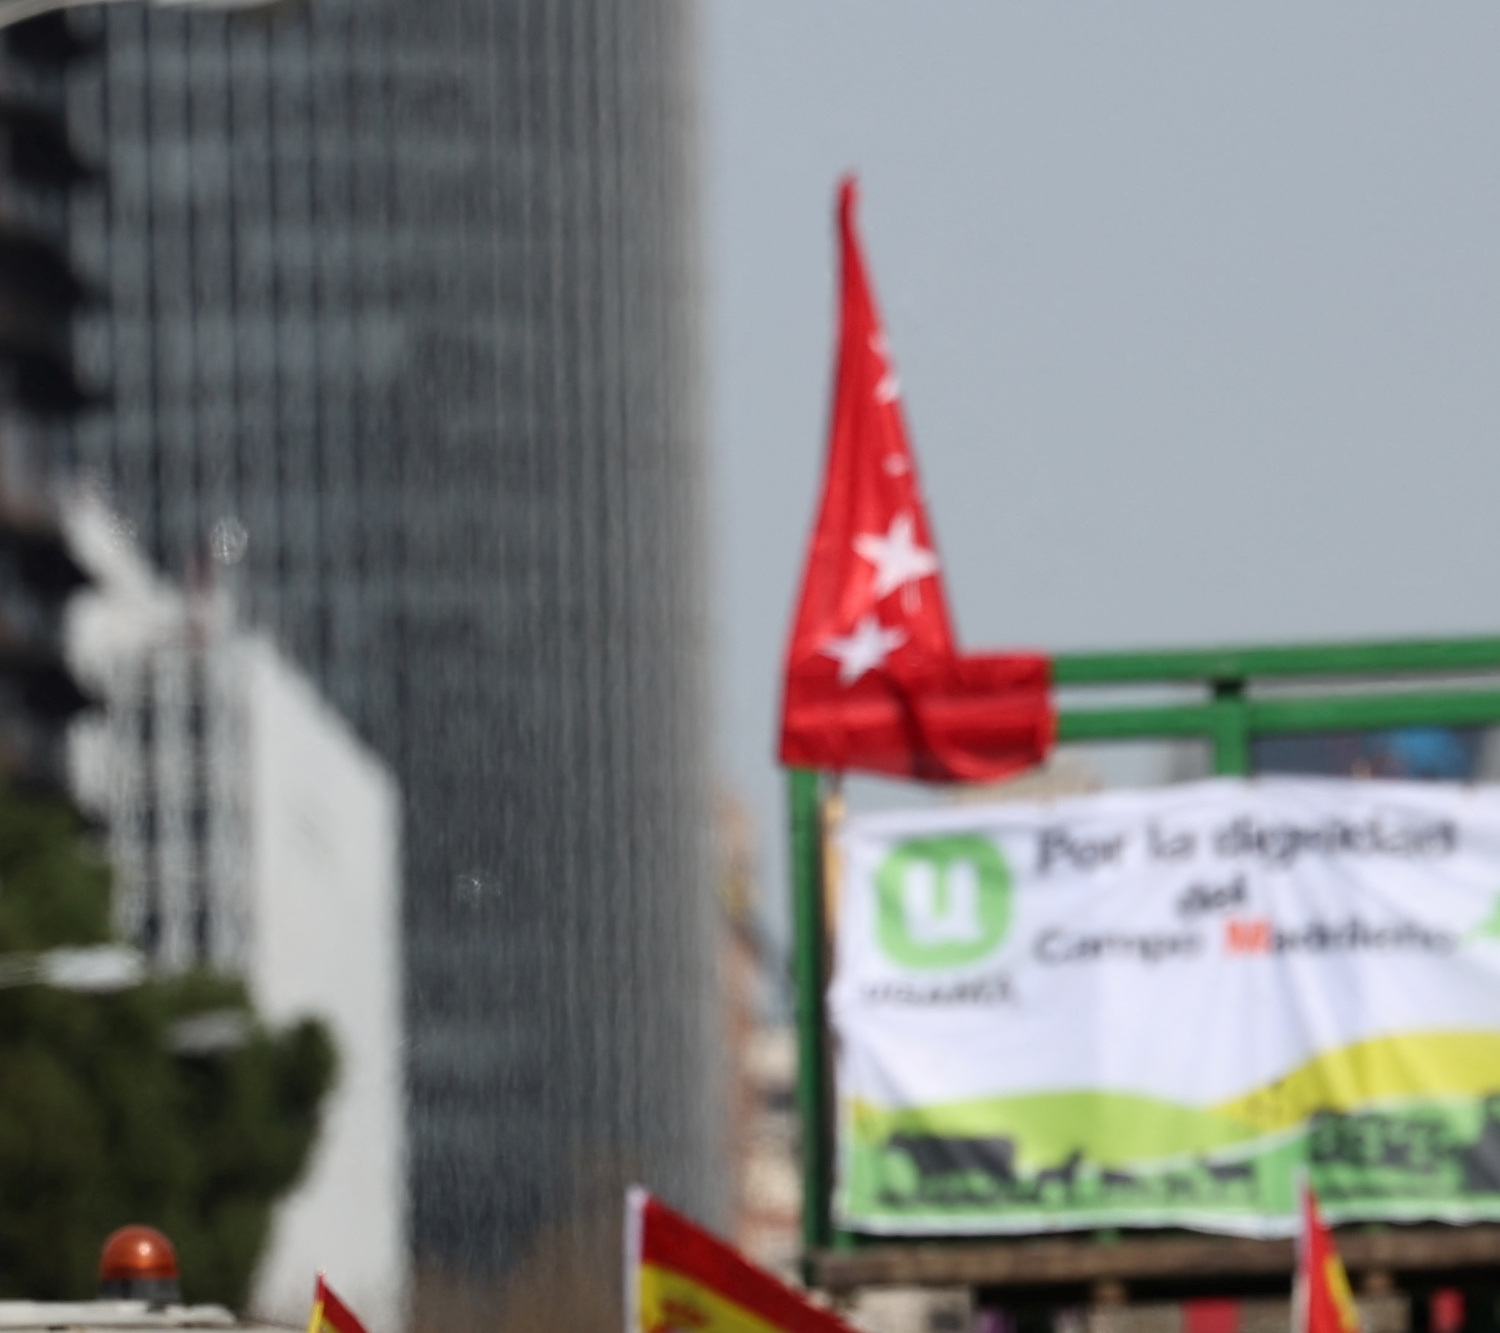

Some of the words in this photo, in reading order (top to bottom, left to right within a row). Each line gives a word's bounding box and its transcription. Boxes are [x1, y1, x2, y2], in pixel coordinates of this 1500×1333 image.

[1034, 828, 1124, 874] Por
[1143, 822, 1198, 860] la
[1211, 815, 1460, 871] dignidad
[1174, 876, 1247, 918] del
[1031, 924, 1199, 968] Campo
